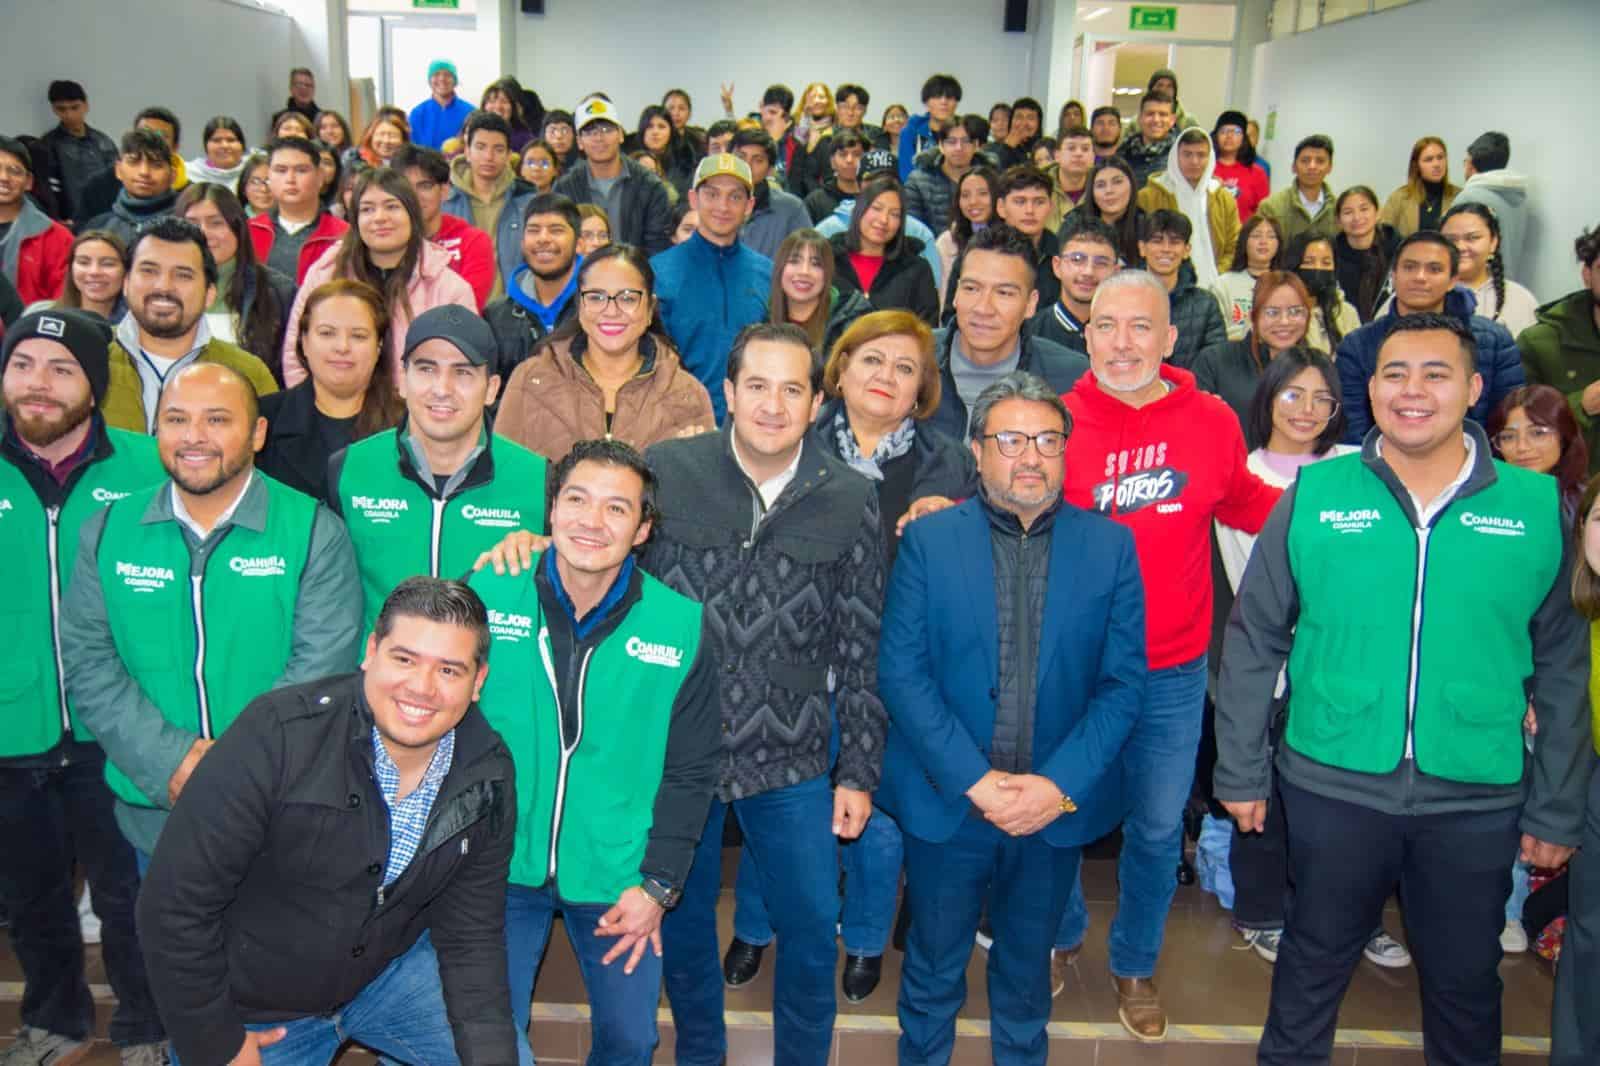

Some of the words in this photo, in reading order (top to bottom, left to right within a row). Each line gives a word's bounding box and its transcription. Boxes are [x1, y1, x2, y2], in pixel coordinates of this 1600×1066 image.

[1100, 470, 1173, 511] POTROS
[352, 496, 409, 510] MEJORA
[461, 504, 520, 519] COAHUILA
[1320, 509, 1381, 523] MEJORA
[1332, 521, 1372, 530] COAHUILA
[1460, 512, 1525, 529] COAHUILA
[116, 561, 174, 581] MEJORA
